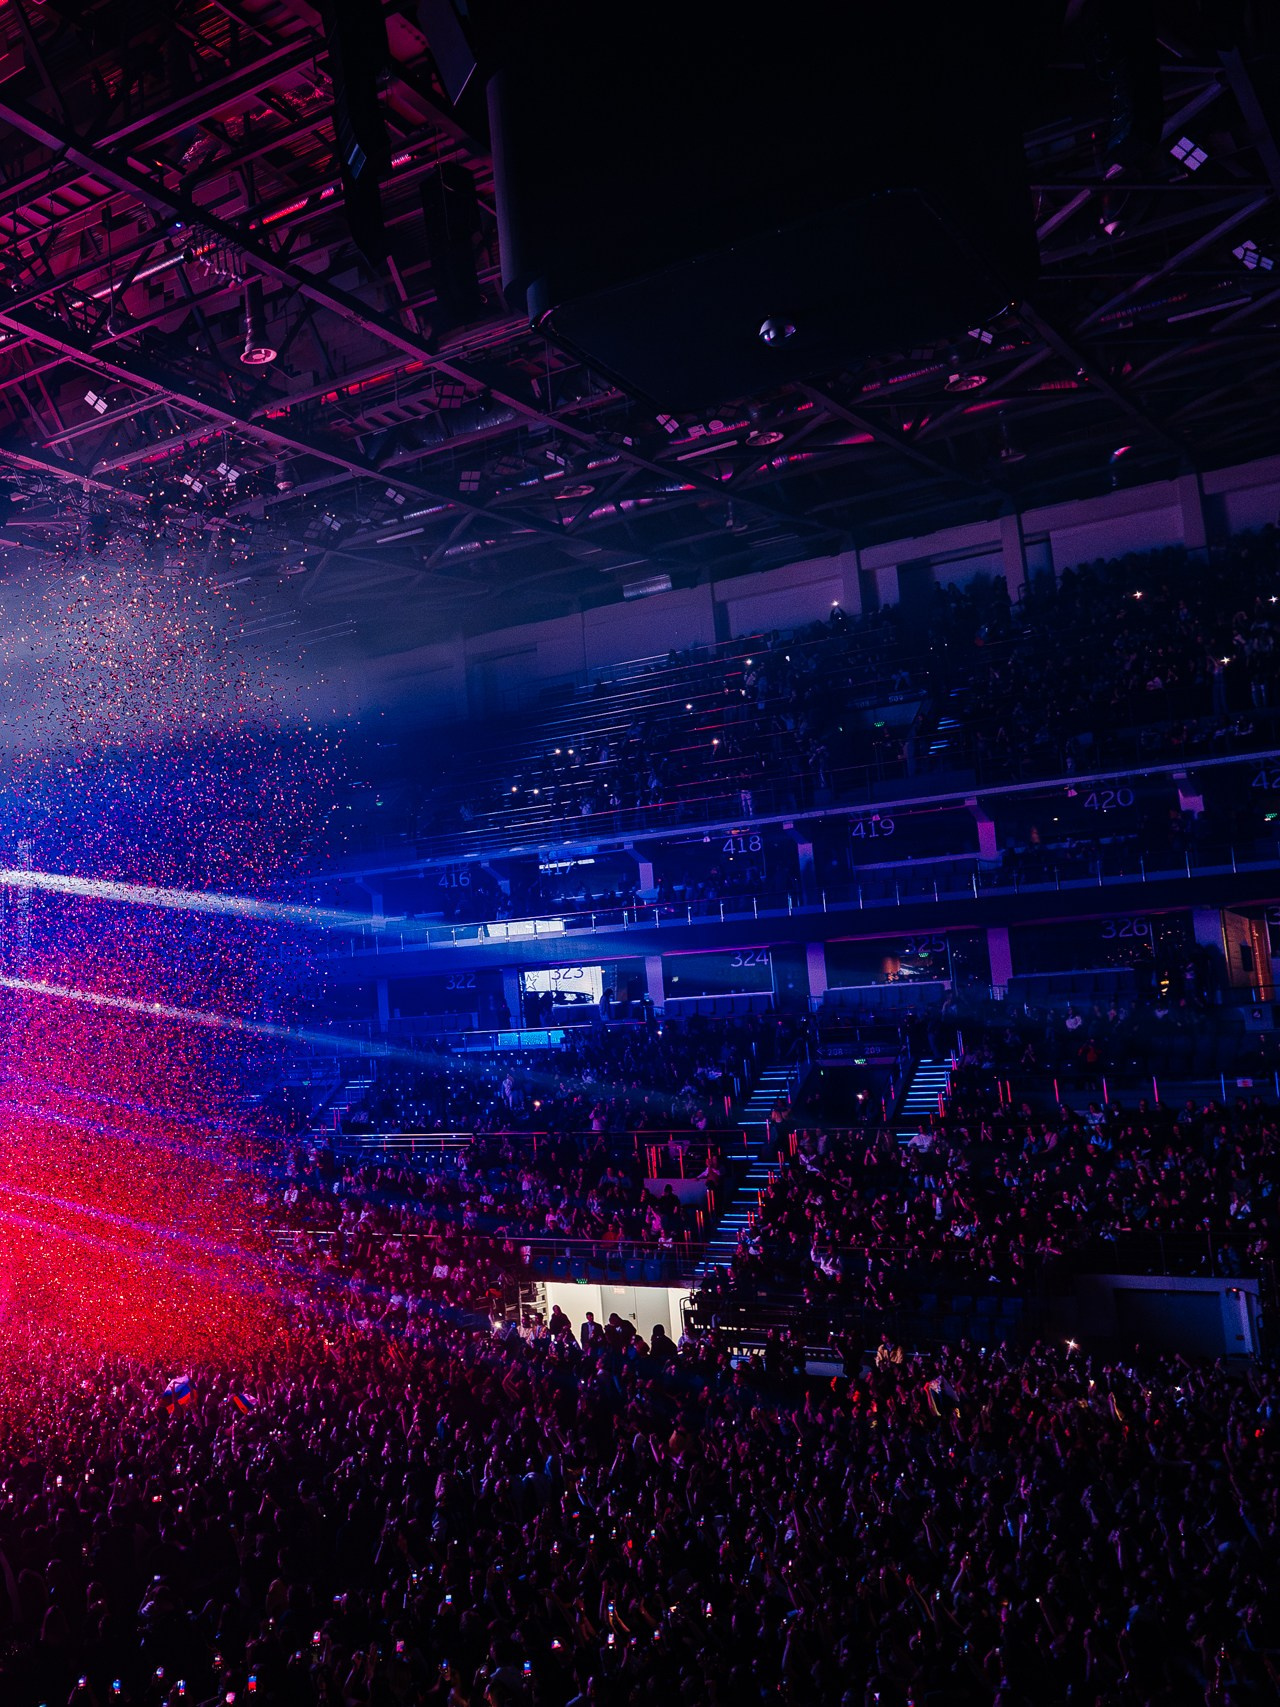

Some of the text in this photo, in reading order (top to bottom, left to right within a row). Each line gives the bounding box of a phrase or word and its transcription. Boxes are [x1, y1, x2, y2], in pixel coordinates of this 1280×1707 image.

[1083, 788, 1135, 810] 420
[851, 817, 895, 839] 419
[722, 835, 762, 854] 418
[541, 857, 575, 876] 417
[438, 871, 470, 888] 416
[1100, 917, 1149, 939] 326
[730, 950, 769, 968] 324
[445, 973, 477, 990] 322
[551, 963, 584, 981] 323
